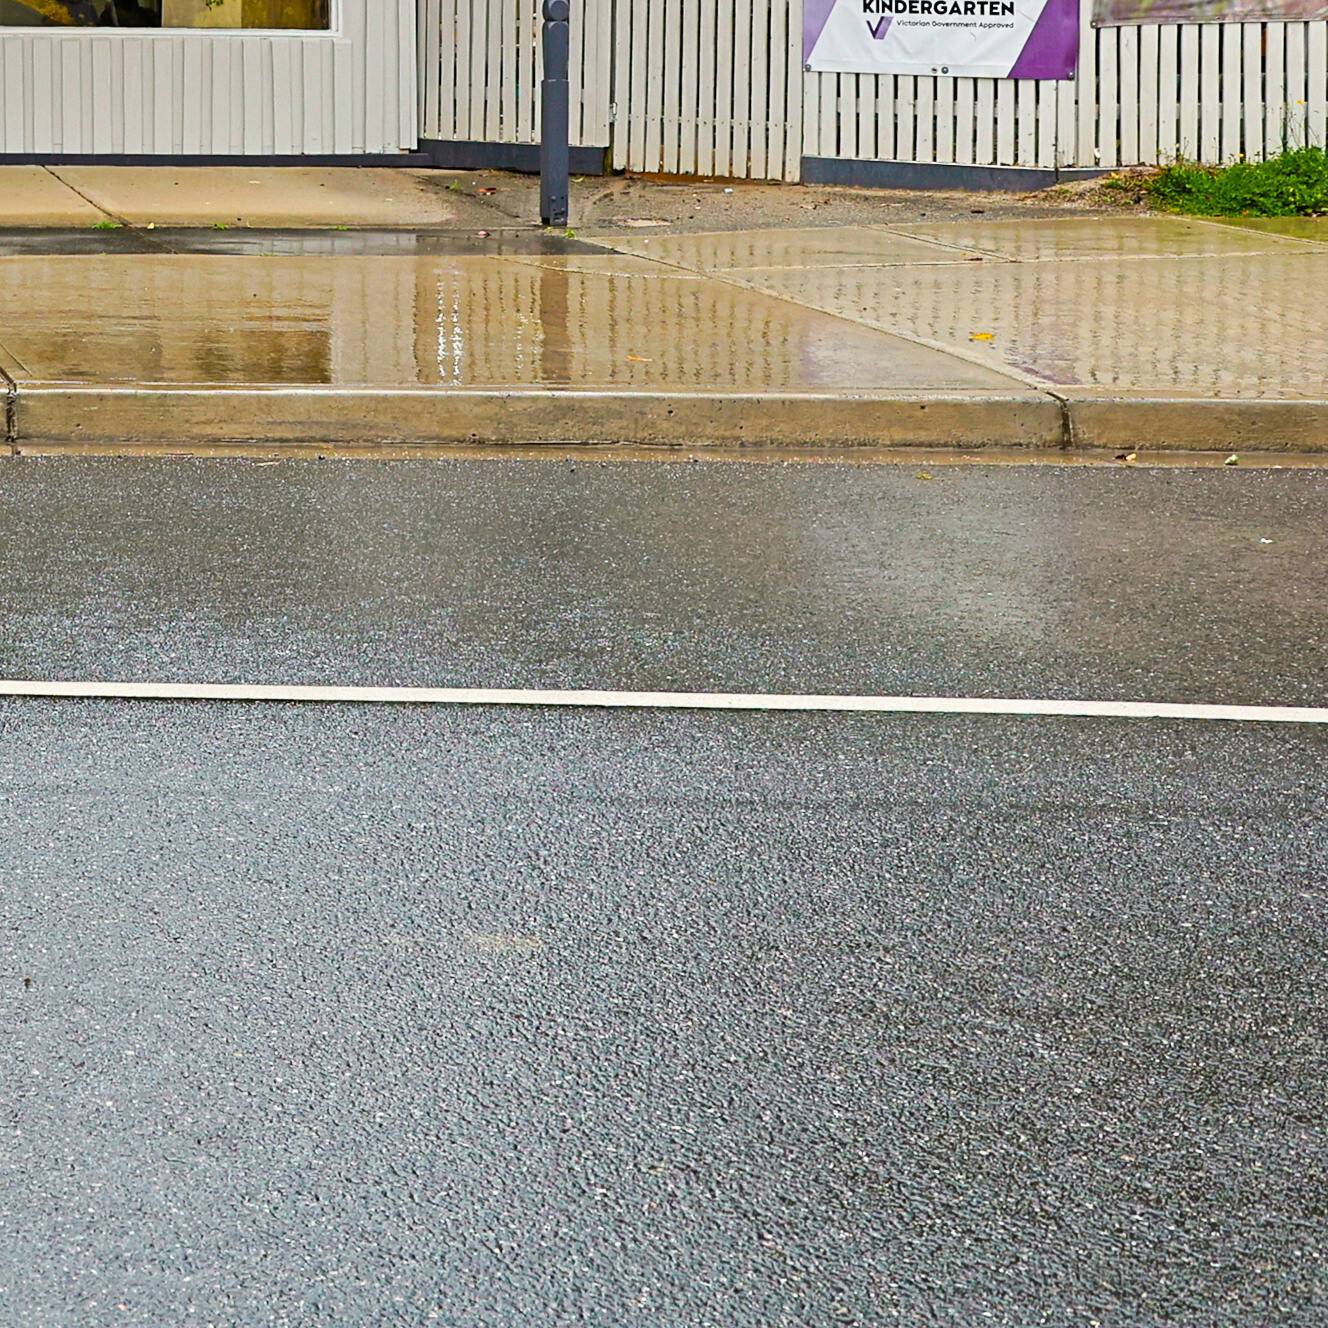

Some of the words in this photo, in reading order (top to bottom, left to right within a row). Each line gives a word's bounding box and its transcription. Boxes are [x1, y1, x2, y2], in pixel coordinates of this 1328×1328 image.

[862, 0, 1015, 16] KINDERGARTEN
[896, 19, 931, 27] Victorian
[932, 20, 977, 28] Government
